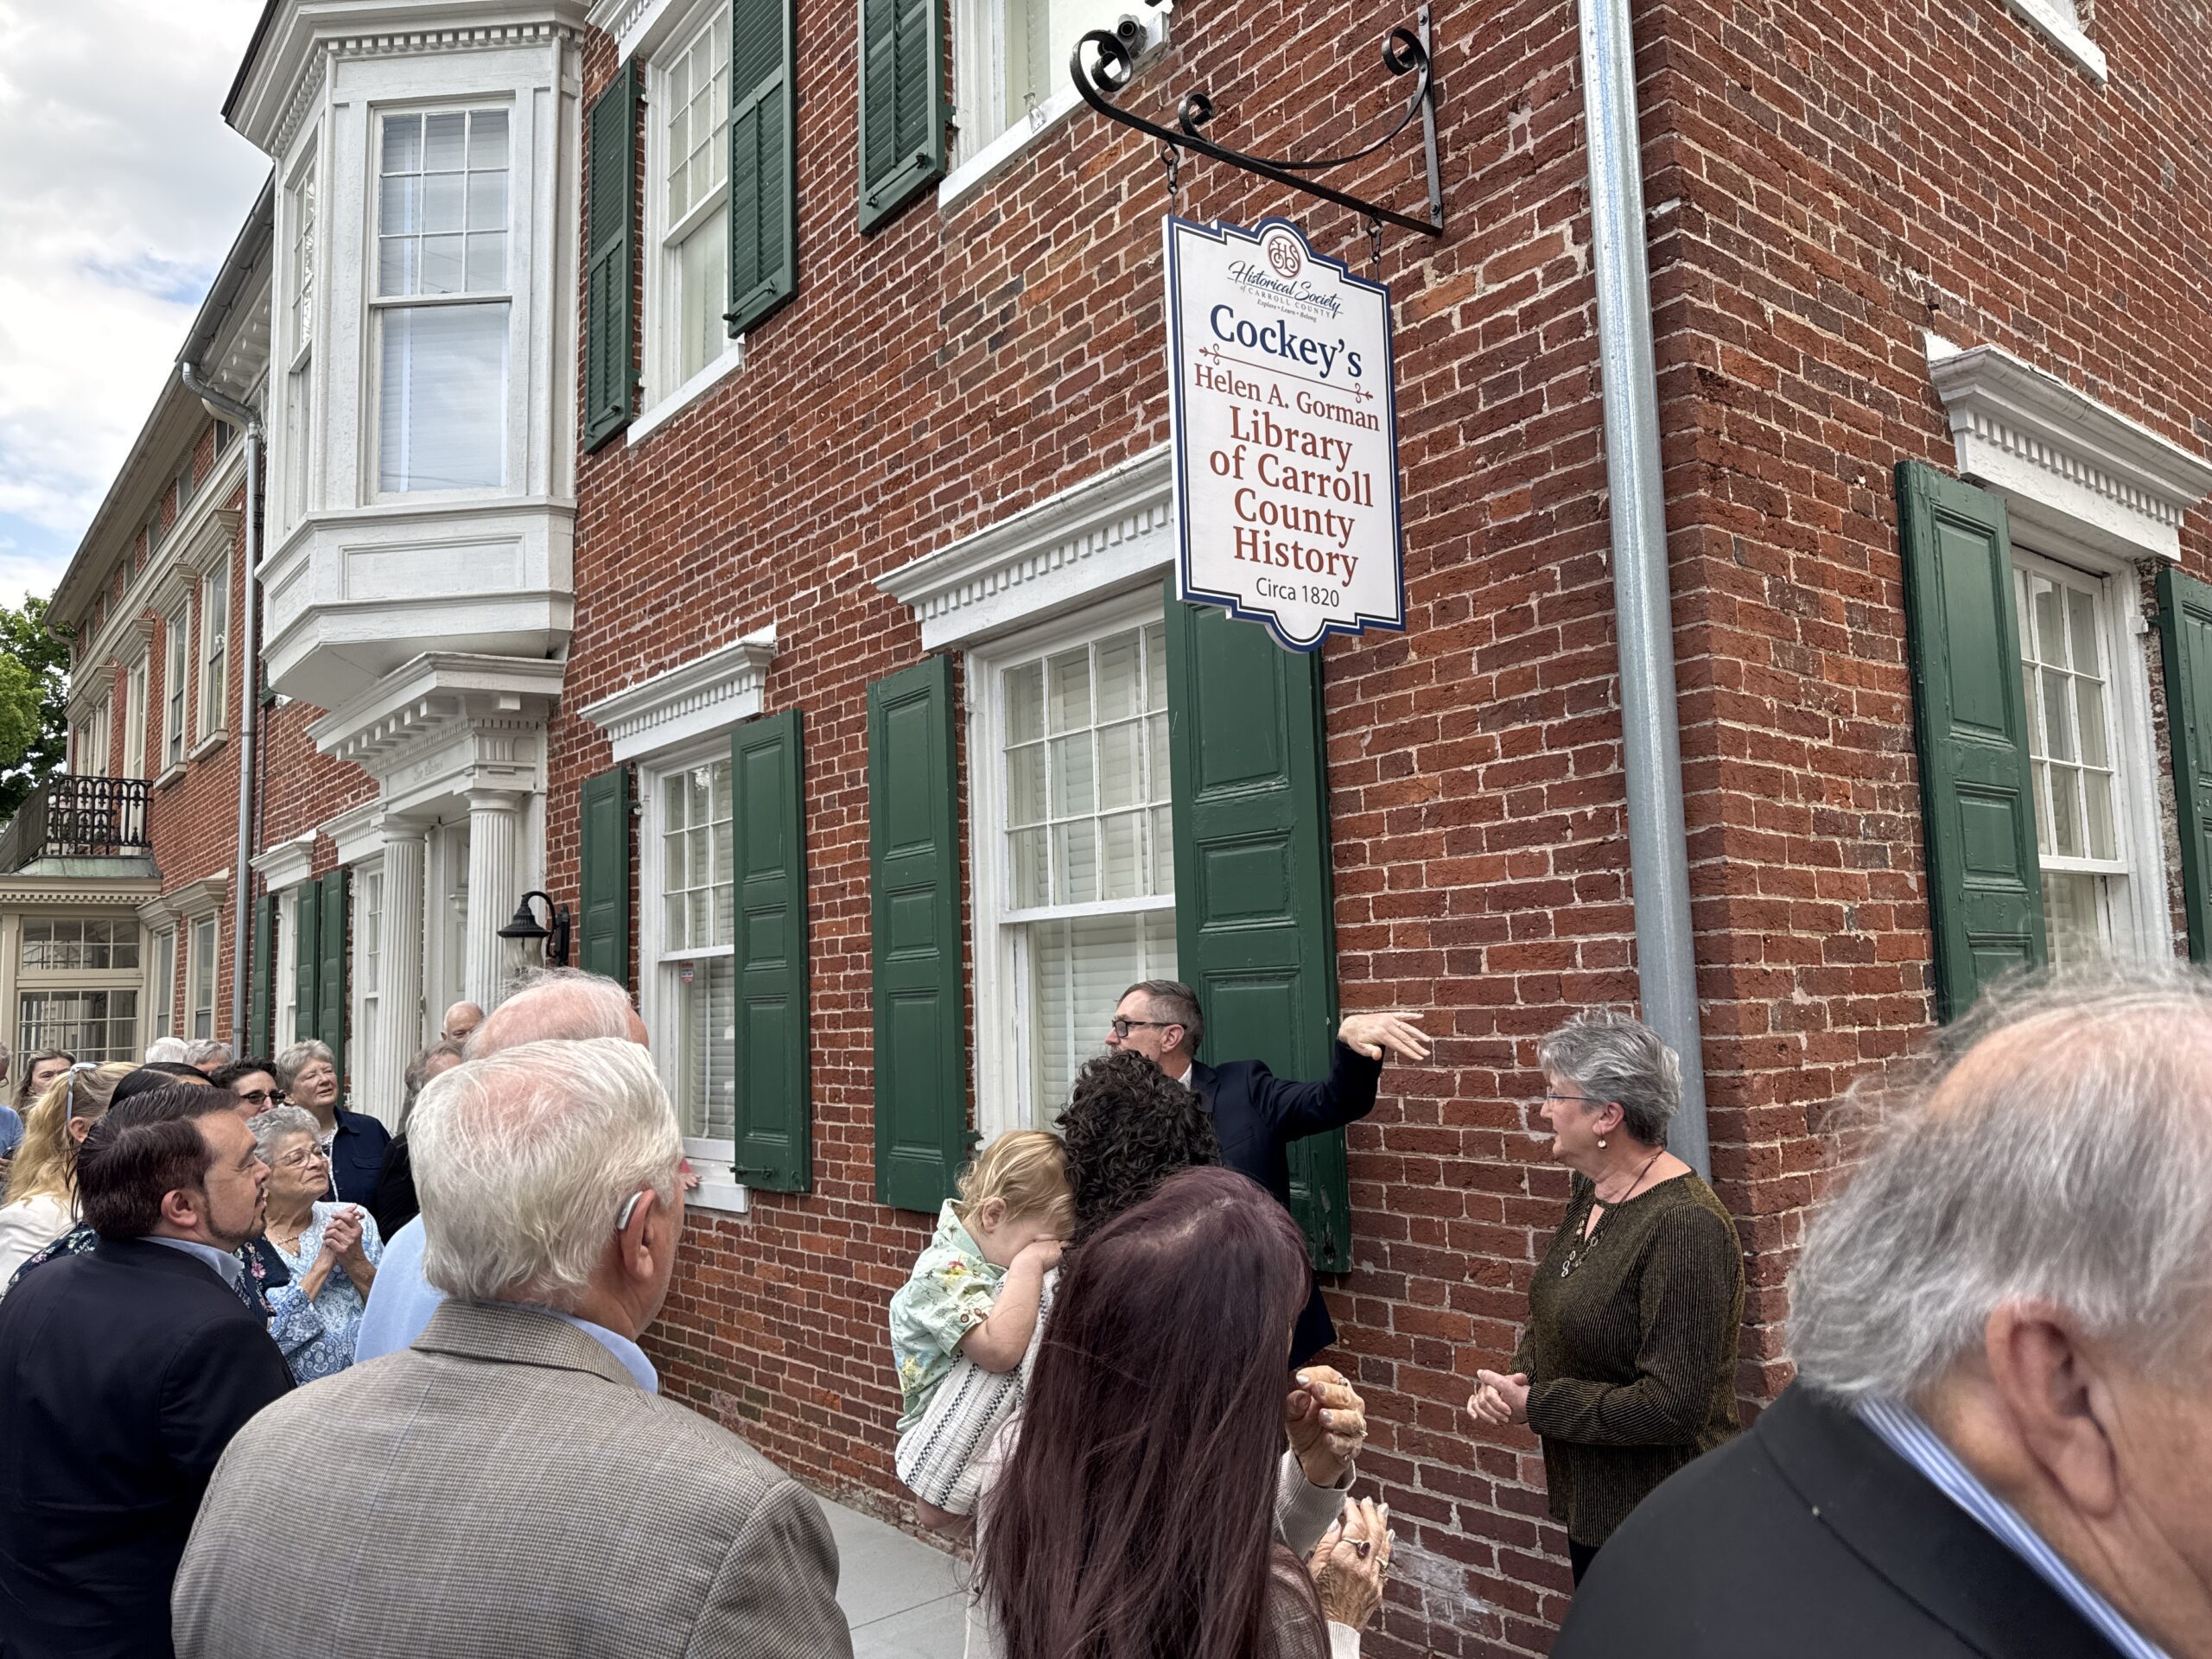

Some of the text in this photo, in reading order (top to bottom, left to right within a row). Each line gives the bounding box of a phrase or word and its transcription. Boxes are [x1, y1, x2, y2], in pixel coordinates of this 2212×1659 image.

[1228, 260, 1342, 320] Historical Society
[1249, 288, 1291, 306] CARROLL
[1294, 302, 1331, 318] COUNTY
[1257, 299, 1317, 323] Explore Learn Belong
[1210, 304, 1363, 378] Cockey's
[1194, 363, 1381, 432] Helen A. Gorman
[1230, 404, 1353, 473] Library
[1210, 444, 1374, 507] of Carroll
[1234, 487, 1356, 549] County
[1233, 525, 1359, 588] History
[1256, 577, 1339, 607] Circa 1820
